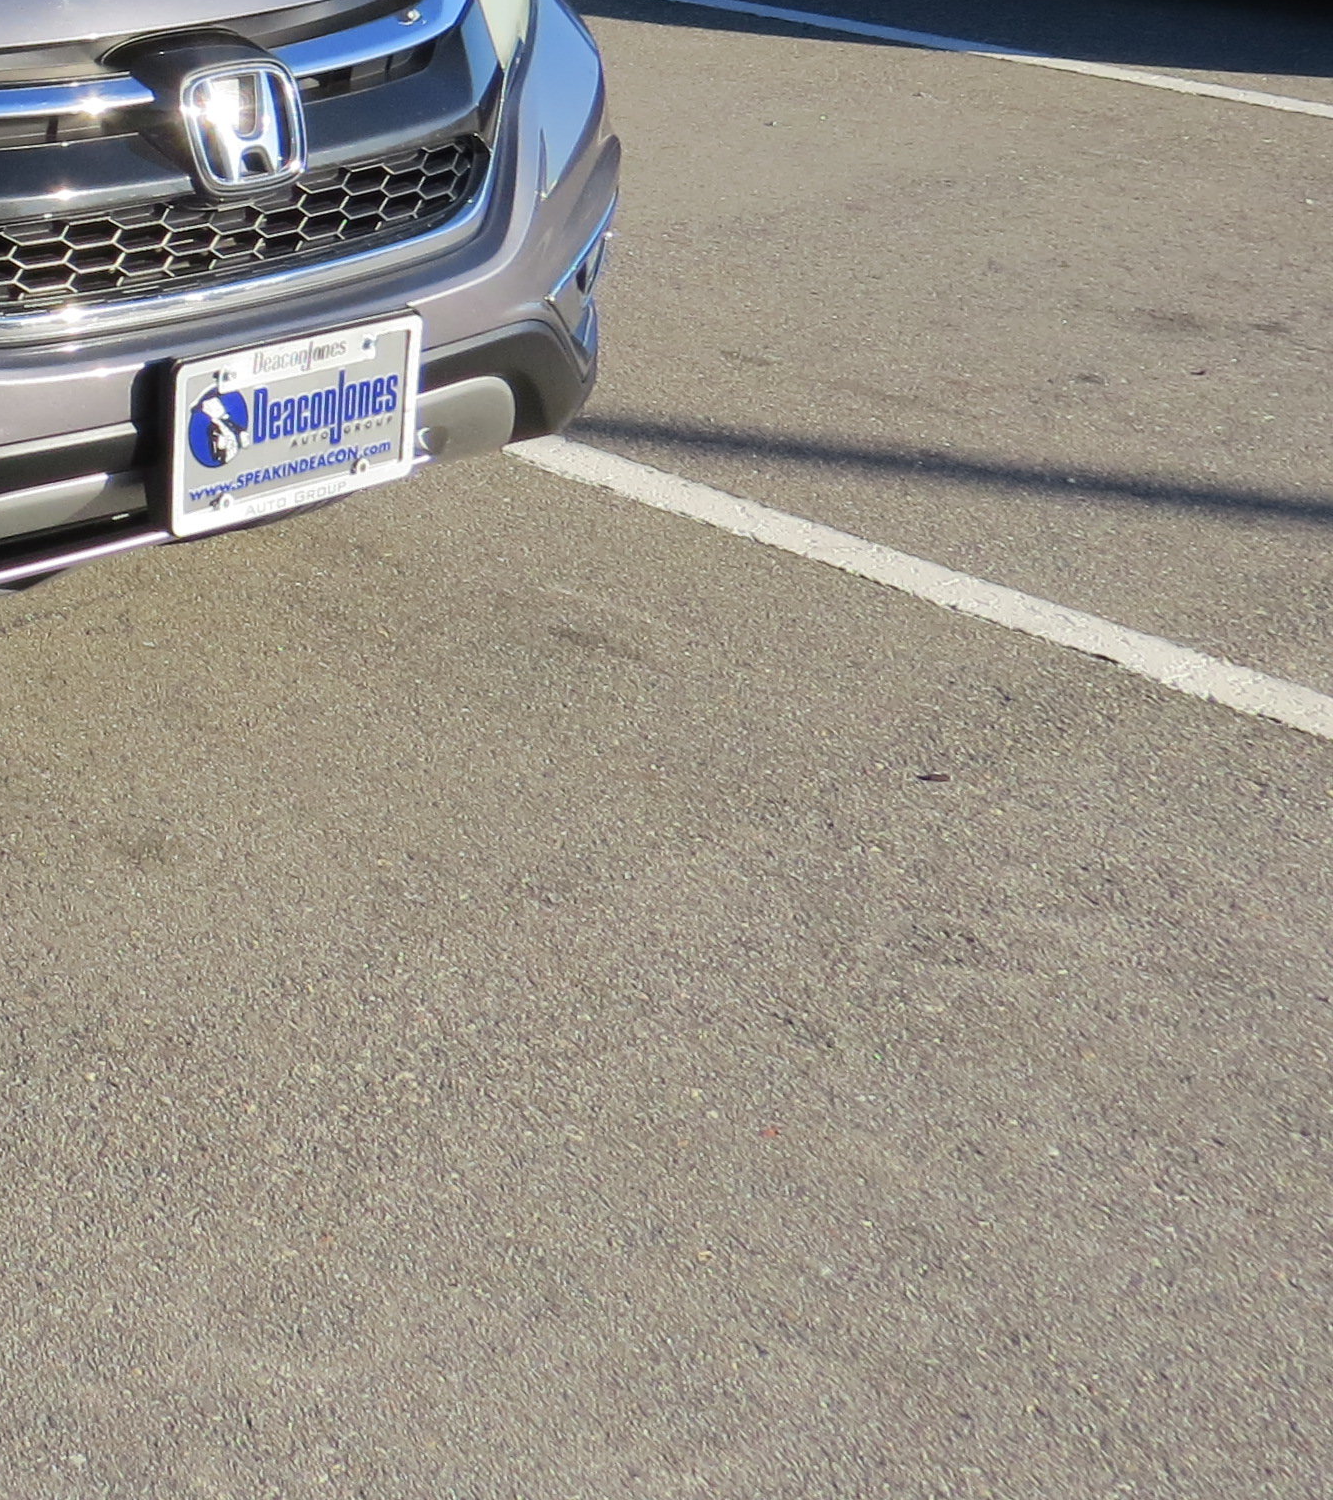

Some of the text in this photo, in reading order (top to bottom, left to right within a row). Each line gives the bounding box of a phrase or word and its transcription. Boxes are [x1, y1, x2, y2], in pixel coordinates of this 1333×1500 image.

[290, 416, 394, 448] AUTO GROUP
[189, 440, 392, 501] www.SPEAKINDEACON.com
[244, 482, 347, 517] AUTO GROUP
